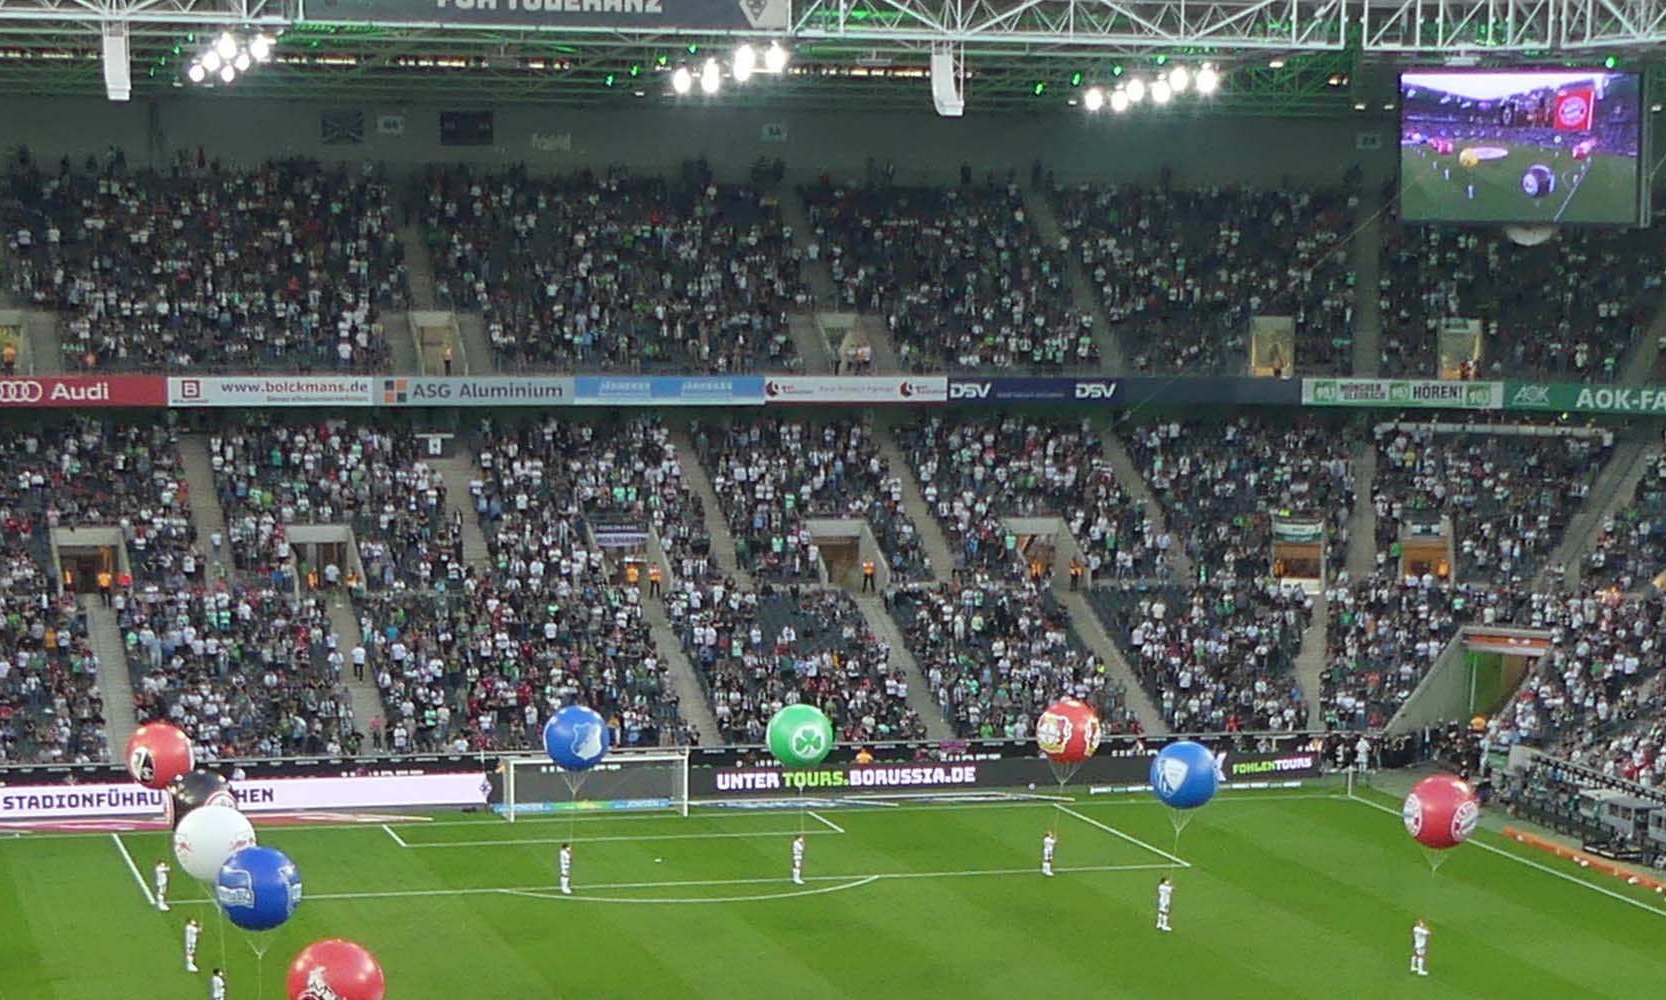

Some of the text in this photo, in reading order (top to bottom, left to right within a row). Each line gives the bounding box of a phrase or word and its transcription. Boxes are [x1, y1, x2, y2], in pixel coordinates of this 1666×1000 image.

[51, 382, 109, 401] Audi
[221, 381, 368, 393] www.bolckmans.de
[413, 383, 564, 399] ASG Aluminium
[950, 383, 992, 399] DSV
[1076, 383, 1116, 399] DSV
[1413, 382, 1463, 400] HÖREN!
[1233, 756, 1312, 775] FOHLENTOURS
[717, 772, 779, 789] UNTER
[3, 788, 163, 811] STADIONFÜHRU
